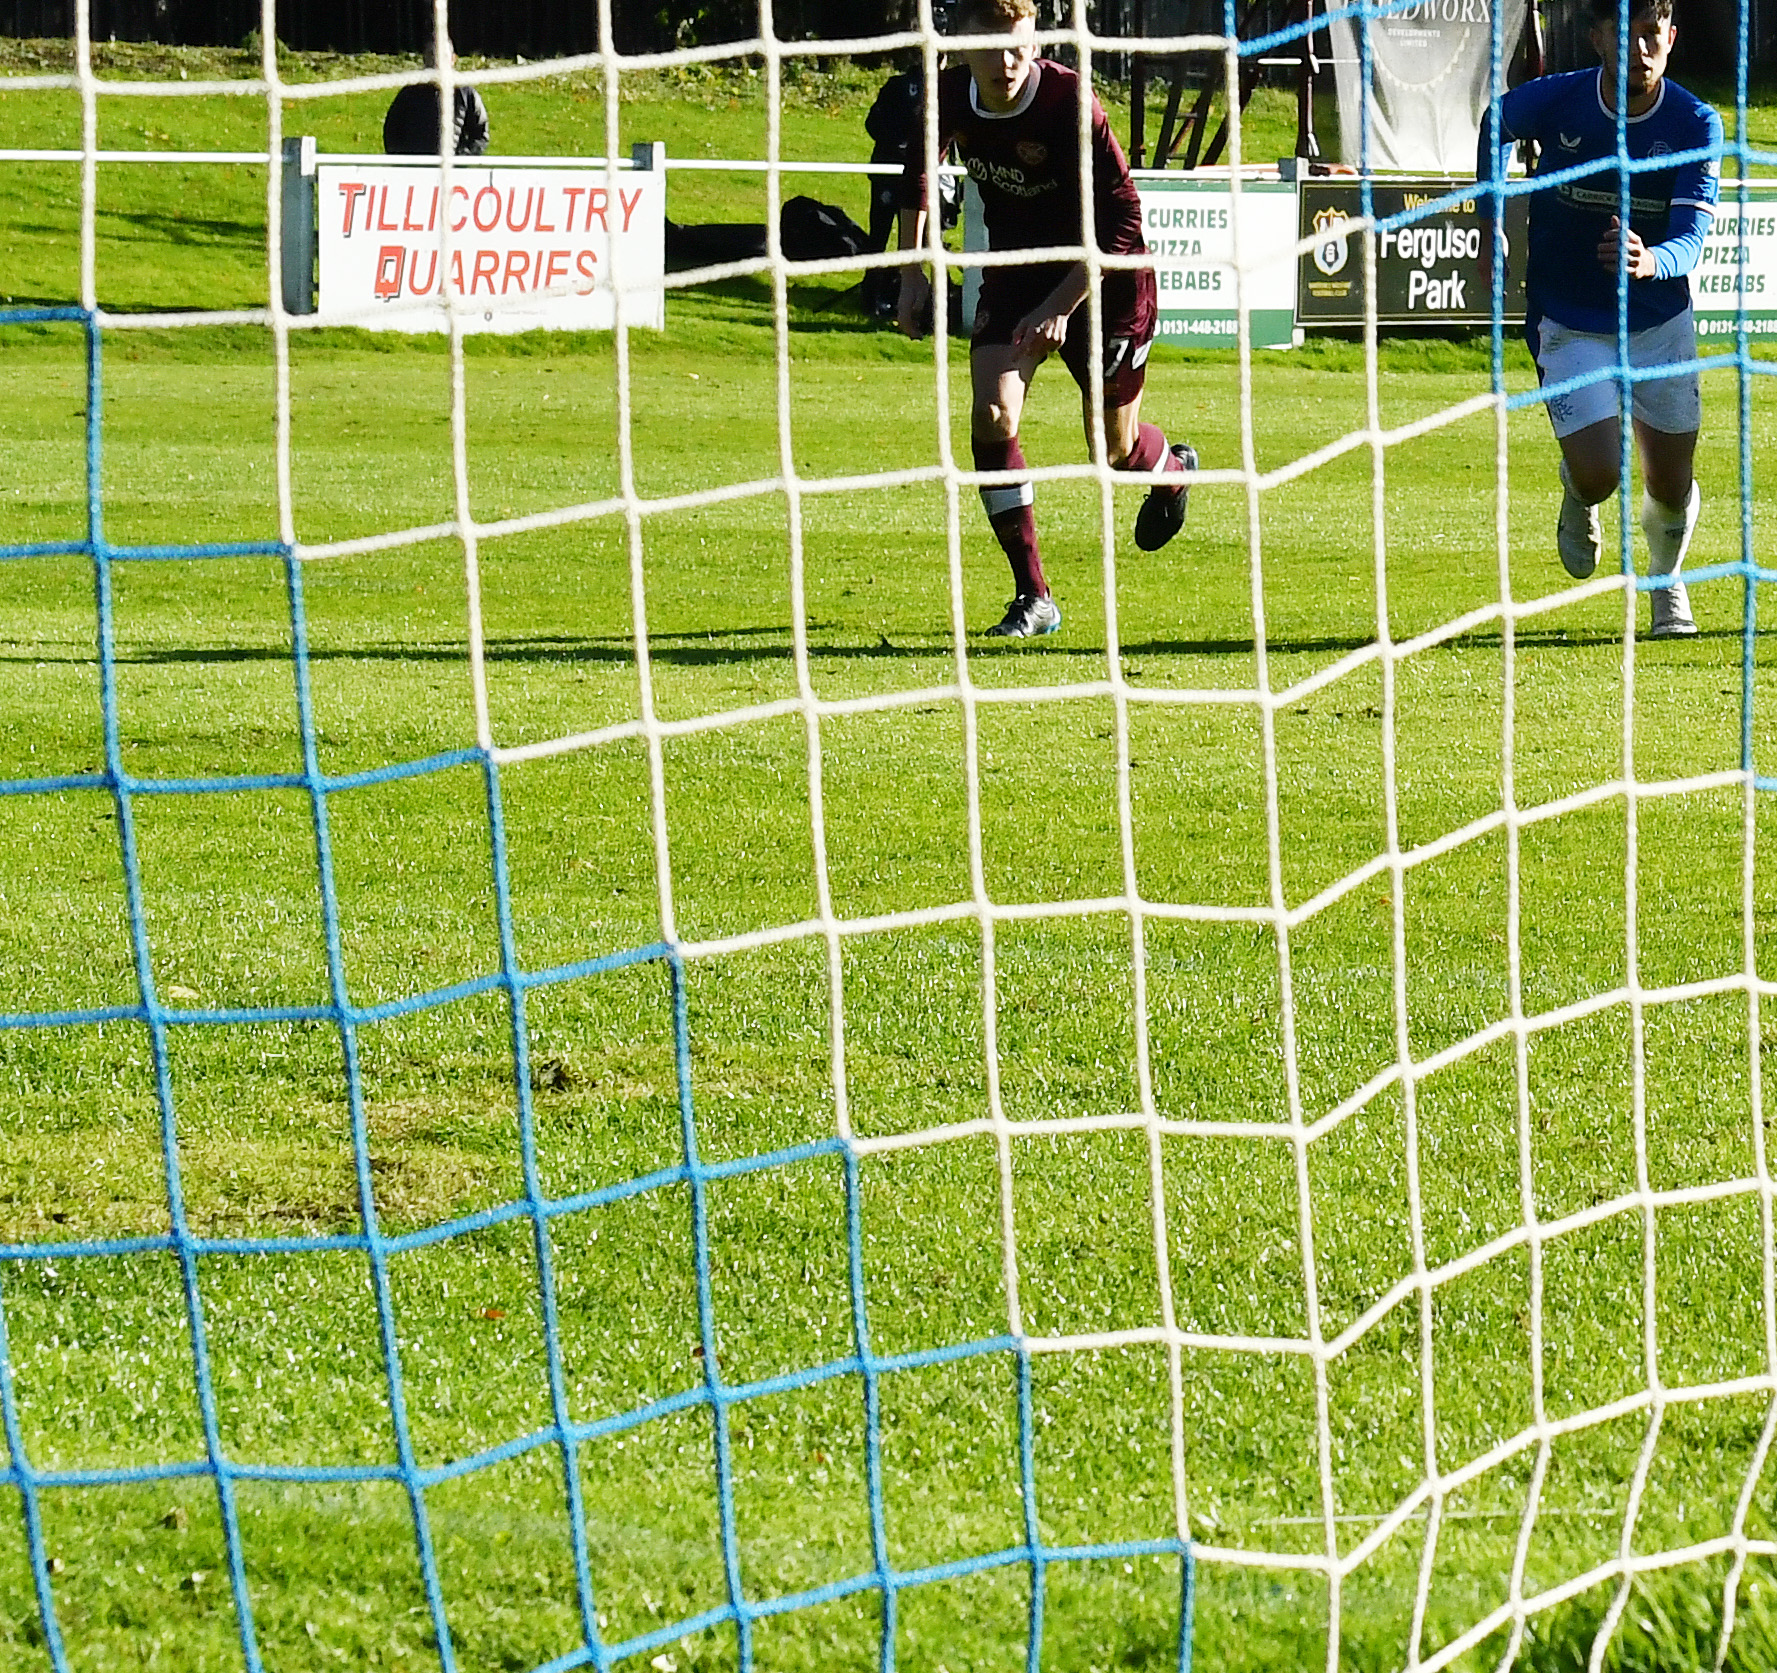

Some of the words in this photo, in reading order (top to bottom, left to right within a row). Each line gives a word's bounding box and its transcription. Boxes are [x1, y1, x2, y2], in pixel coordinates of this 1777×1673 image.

[338, 182, 643, 238] TILLICOULTRY
[1147, 208, 1228, 229] CURRIES
[1147, 240, 1202, 255] PIZZA
[1702, 246, 1750, 264] PIZZA
[373, 245, 598, 302] QUARRIES
[1155, 271, 1222, 291] EBABS
[1699, 274, 1766, 293] KEBABS
[1407, 270, 1467, 310] Park
